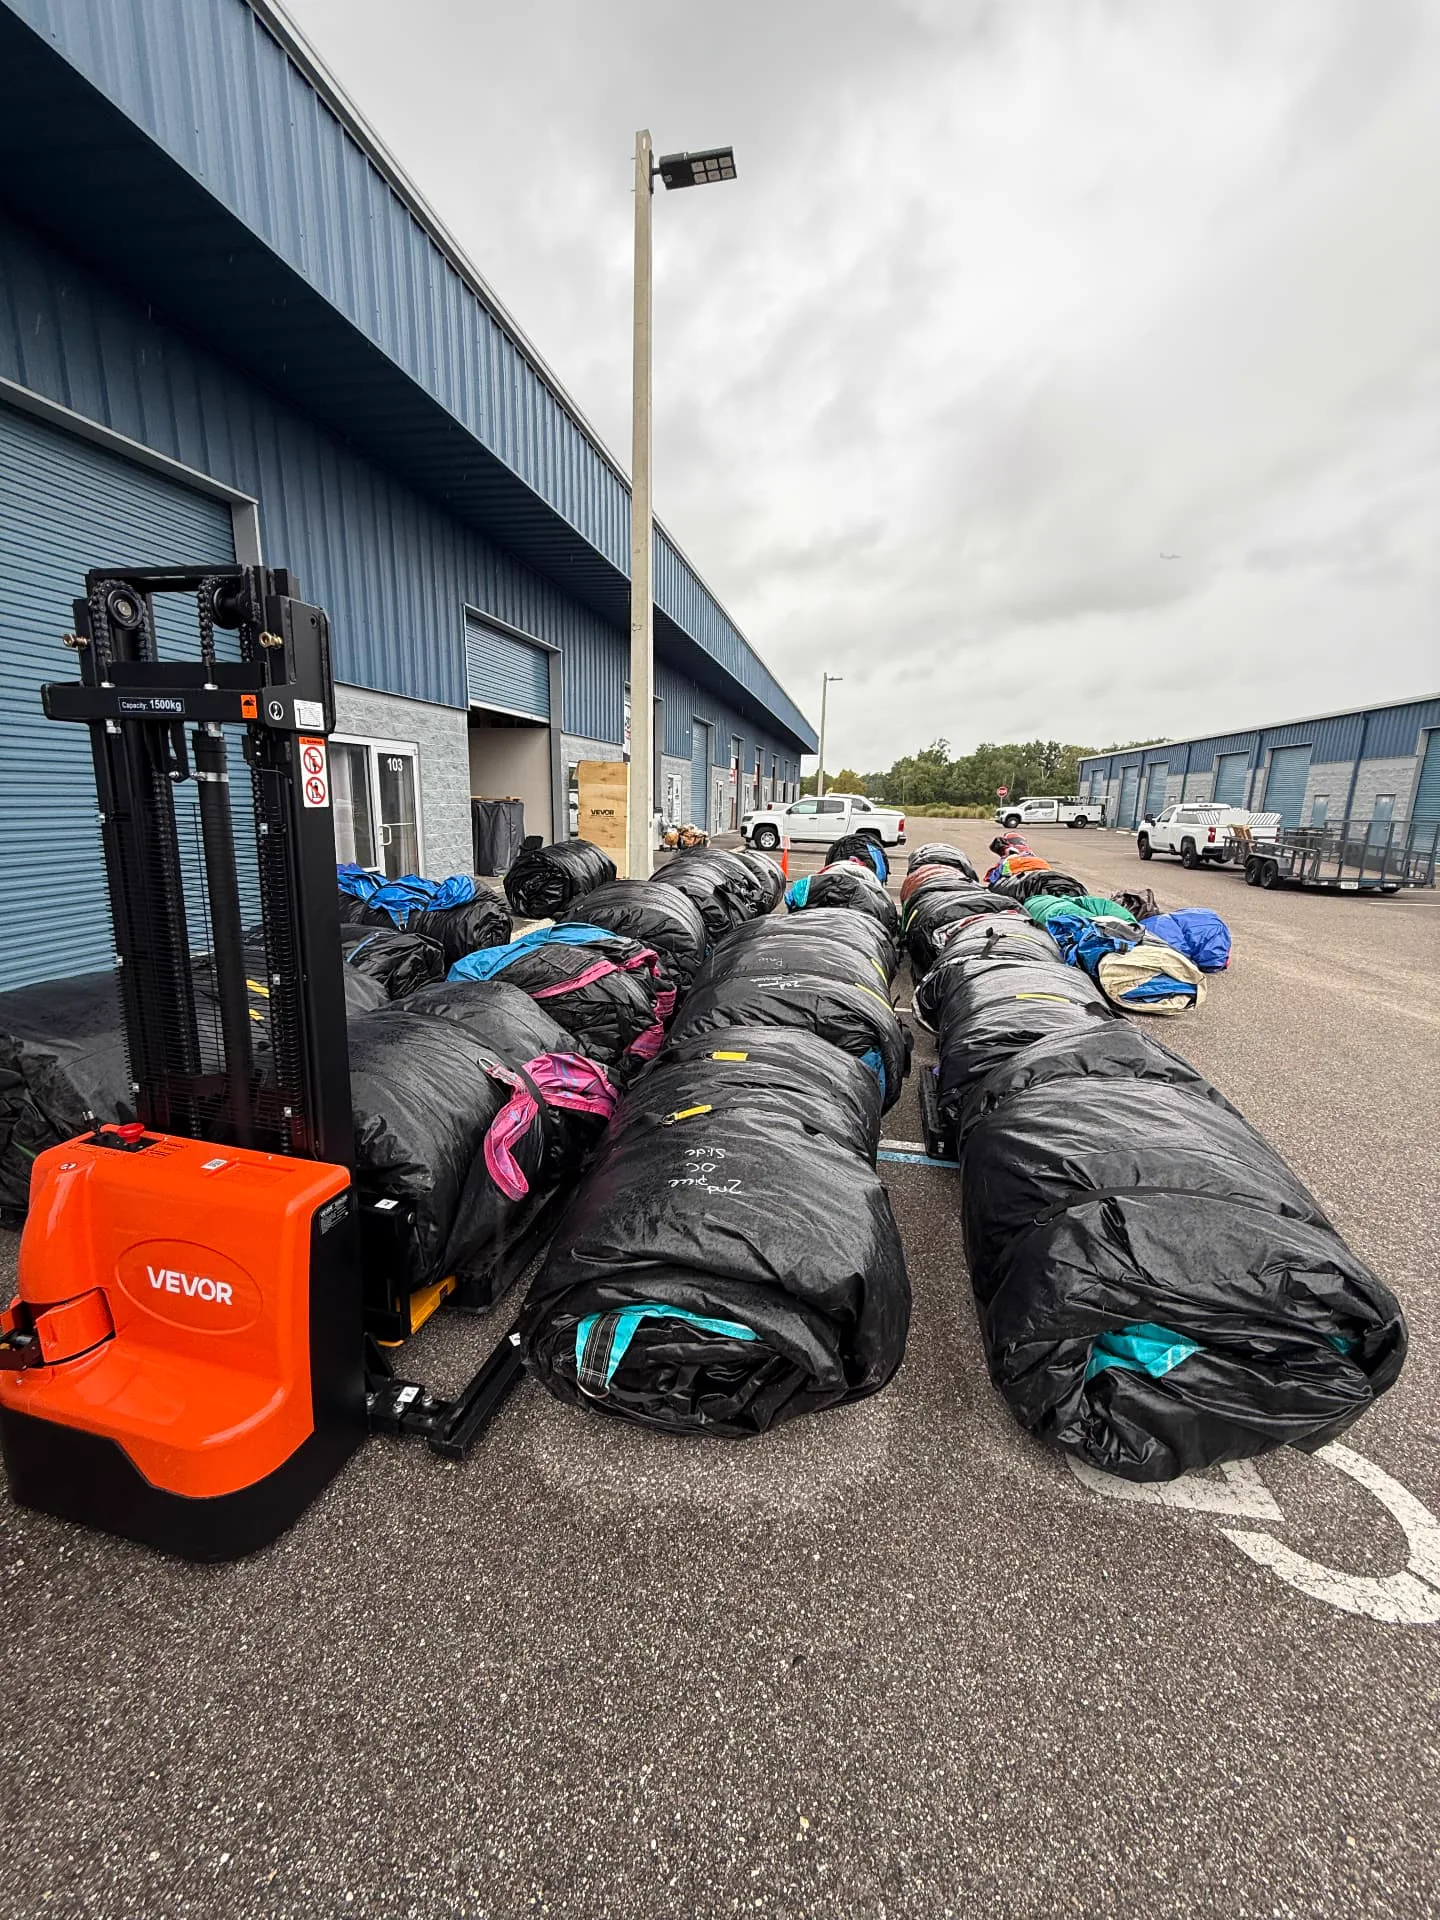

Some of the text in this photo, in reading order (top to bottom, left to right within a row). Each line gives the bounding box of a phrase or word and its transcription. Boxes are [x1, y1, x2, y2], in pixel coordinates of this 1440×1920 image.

[150, 699, 182, 712] 1500kg
[387, 757, 403, 772] 103
[684, 1148, 726, 1159] Slide
[706, 1179, 742, 1195] 2nd
[146, 1265, 233, 1306] VEVOR
